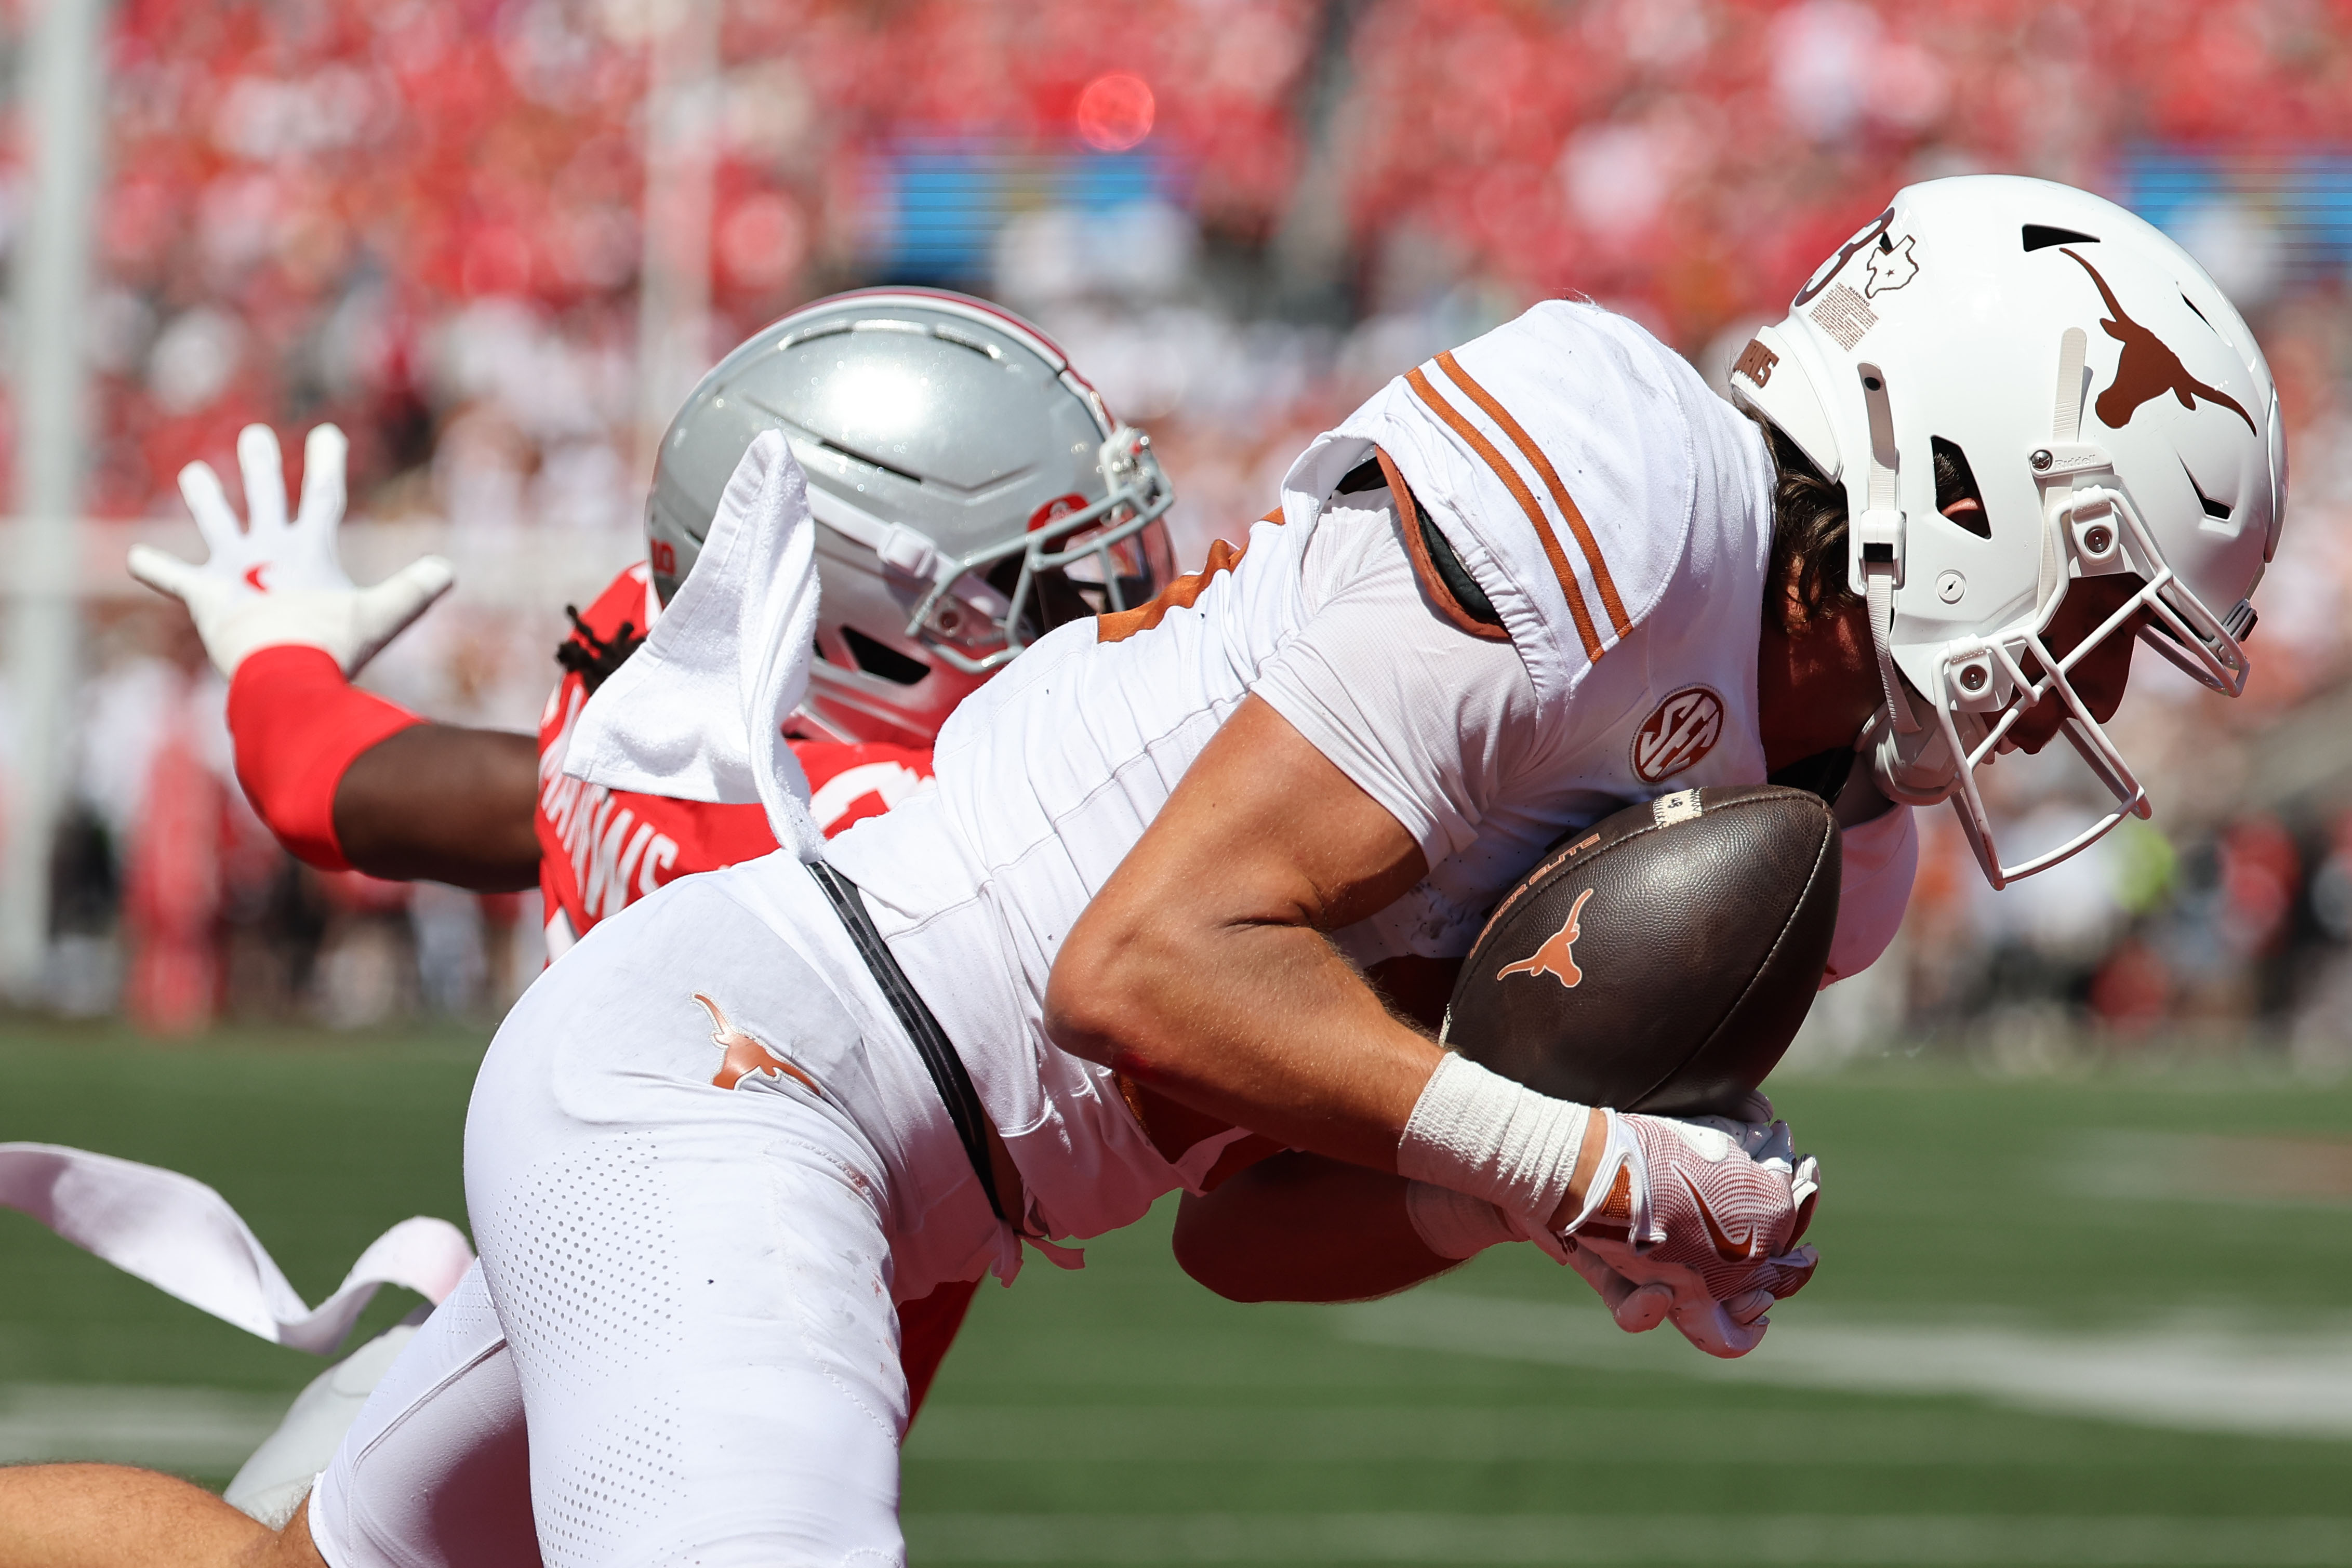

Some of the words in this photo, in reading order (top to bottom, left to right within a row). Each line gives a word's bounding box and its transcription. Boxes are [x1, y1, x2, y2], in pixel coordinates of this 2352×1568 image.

[1848, 286, 1870, 307] WARNING
[2054, 454, 2097, 470] Riddell
[1640, 693, 1720, 780] SEC
[1529, 832, 1601, 885] ELITE
